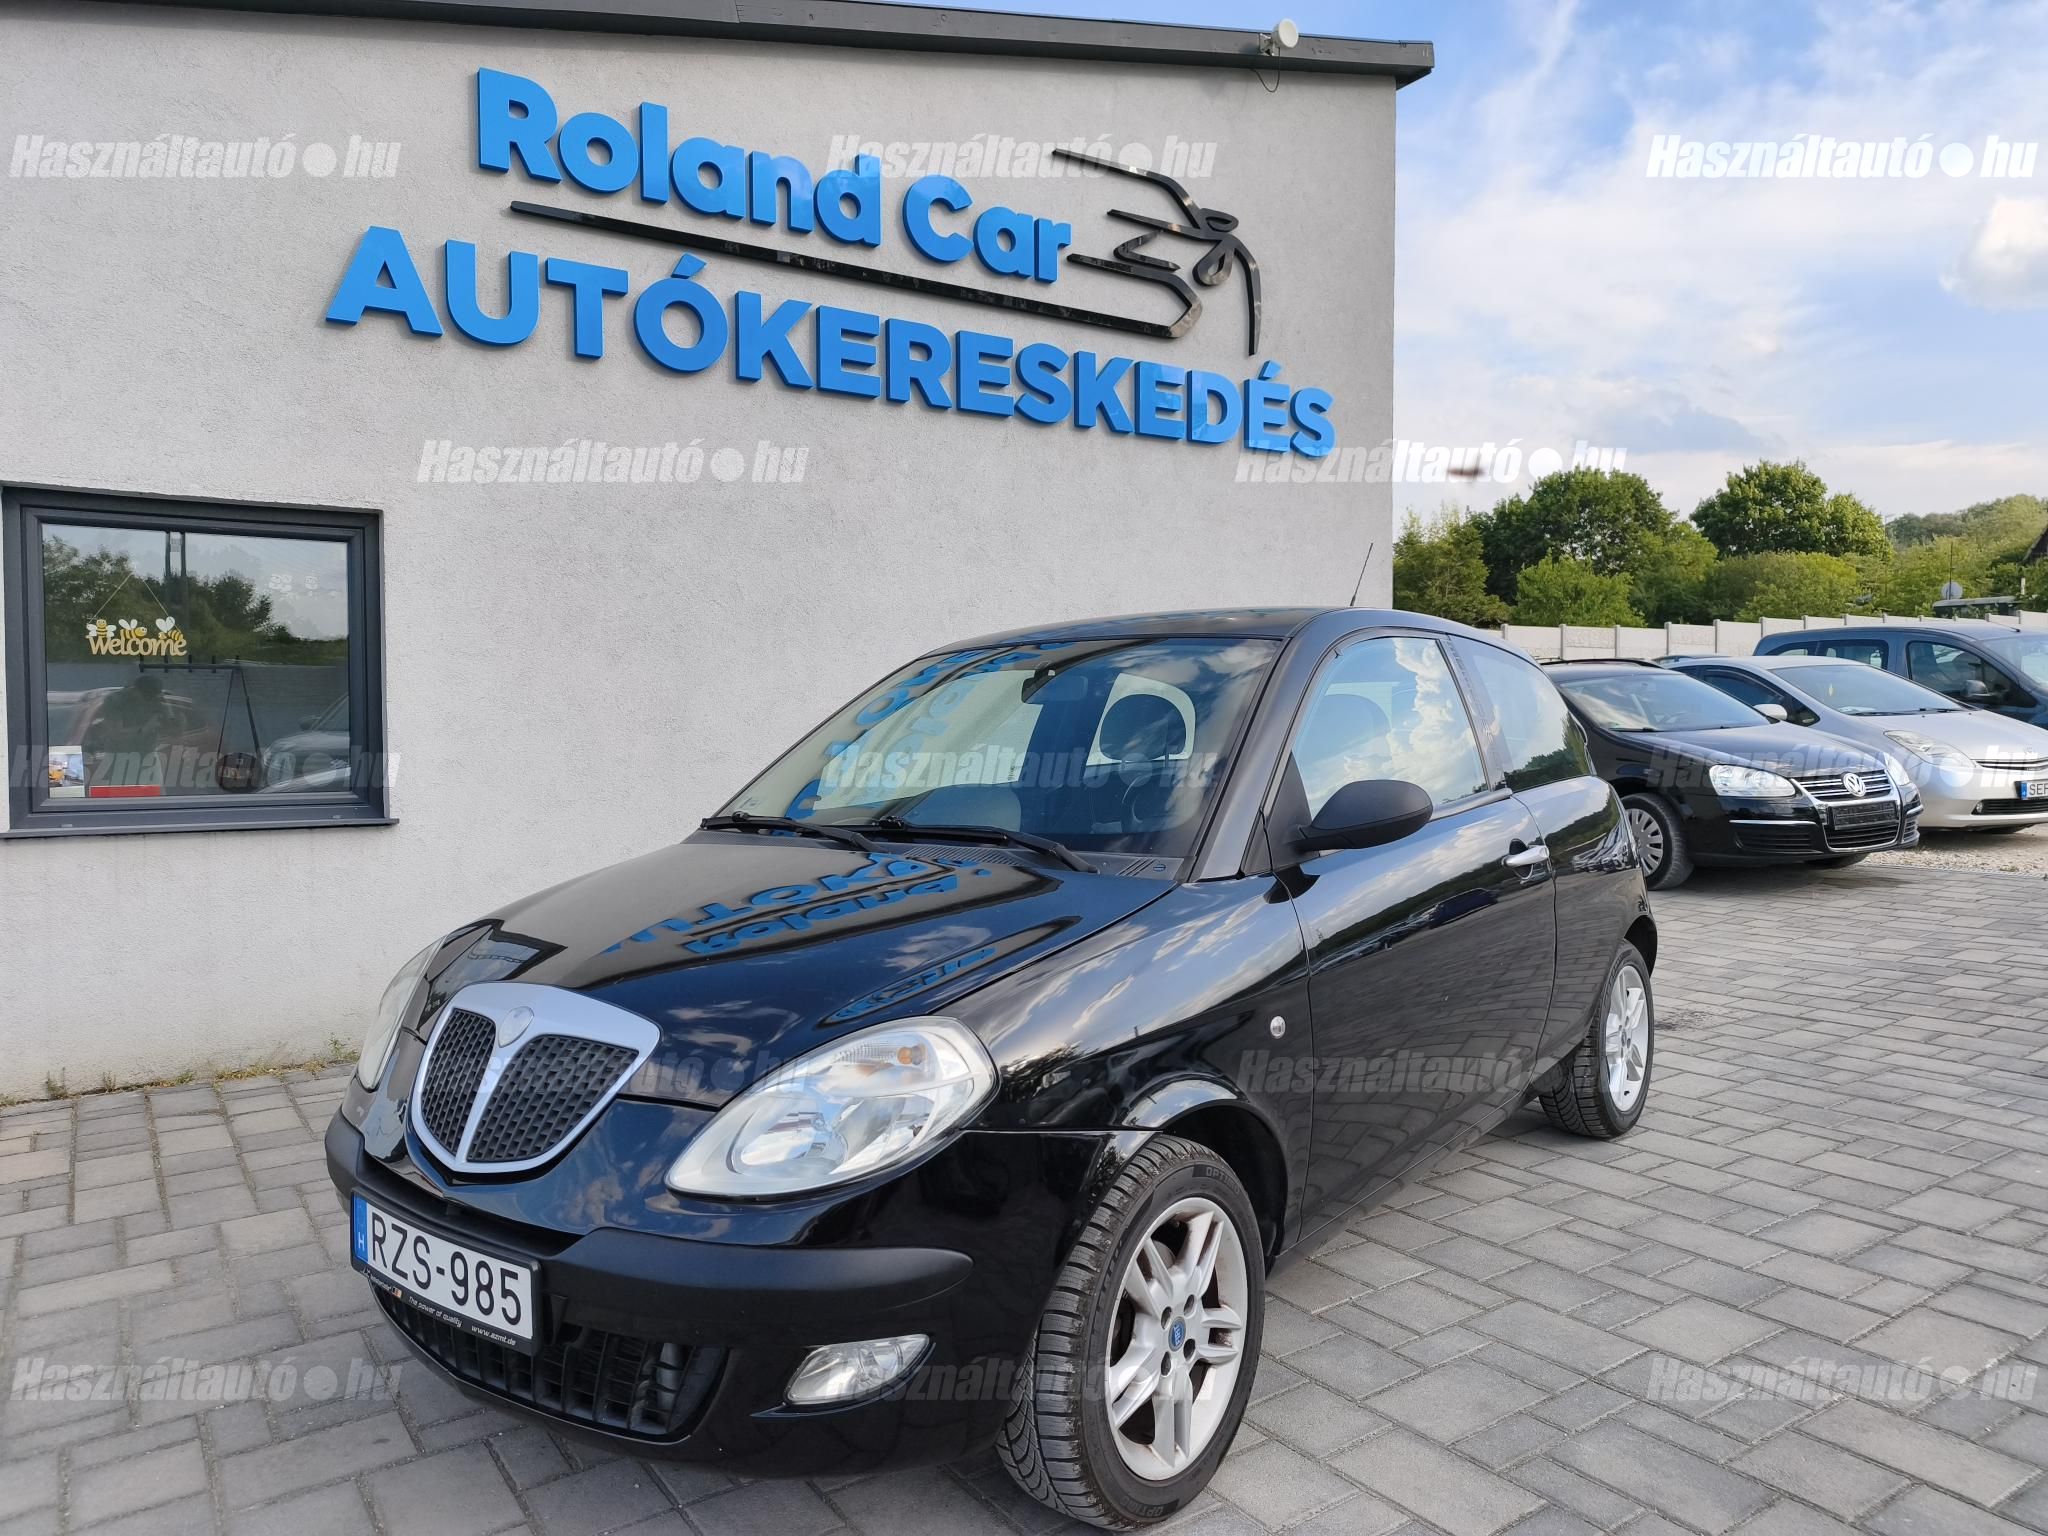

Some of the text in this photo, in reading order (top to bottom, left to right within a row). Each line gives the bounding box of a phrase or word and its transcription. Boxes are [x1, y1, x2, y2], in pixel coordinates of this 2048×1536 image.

[478, 67, 1071, 283] Roland Car
[325, 225, 1338, 458] AUTÓKERESKEDÉS
[357, 1231, 365, 1247] H
[371, 1211, 522, 1326] RZS-985
